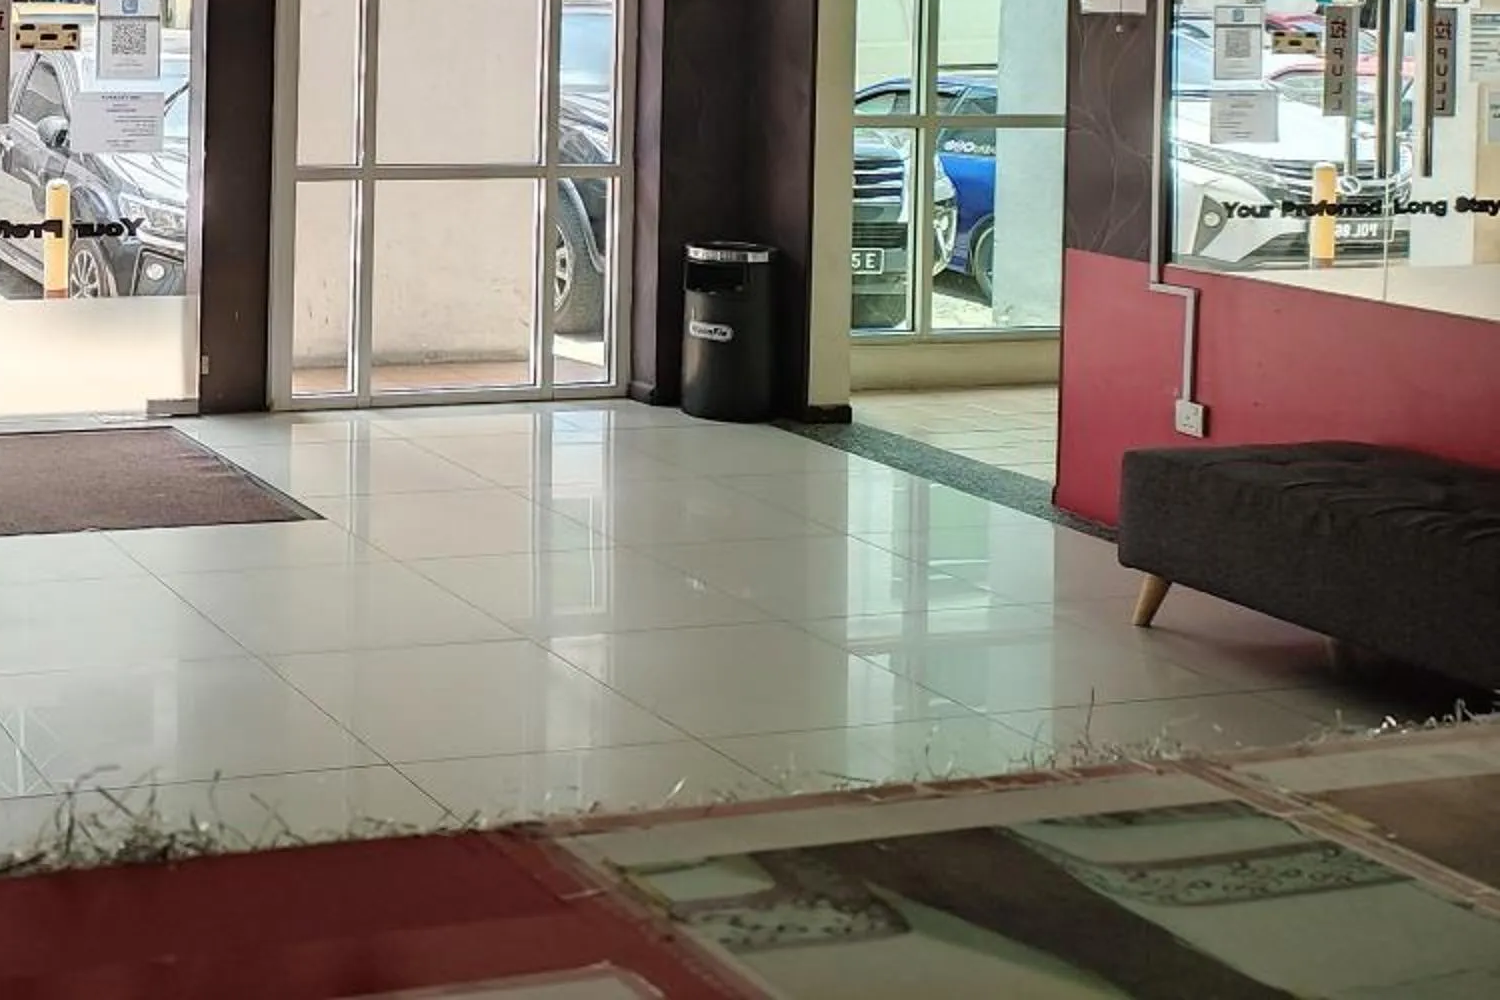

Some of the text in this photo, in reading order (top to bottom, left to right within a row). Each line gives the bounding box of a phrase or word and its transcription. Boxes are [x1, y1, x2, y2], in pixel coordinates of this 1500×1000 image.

[1224, 201, 1276, 219] Your
[1280, 199, 1382, 218] Preferred
[1394, 199, 1448, 217] Long
[865, 252, 877, 269] E
